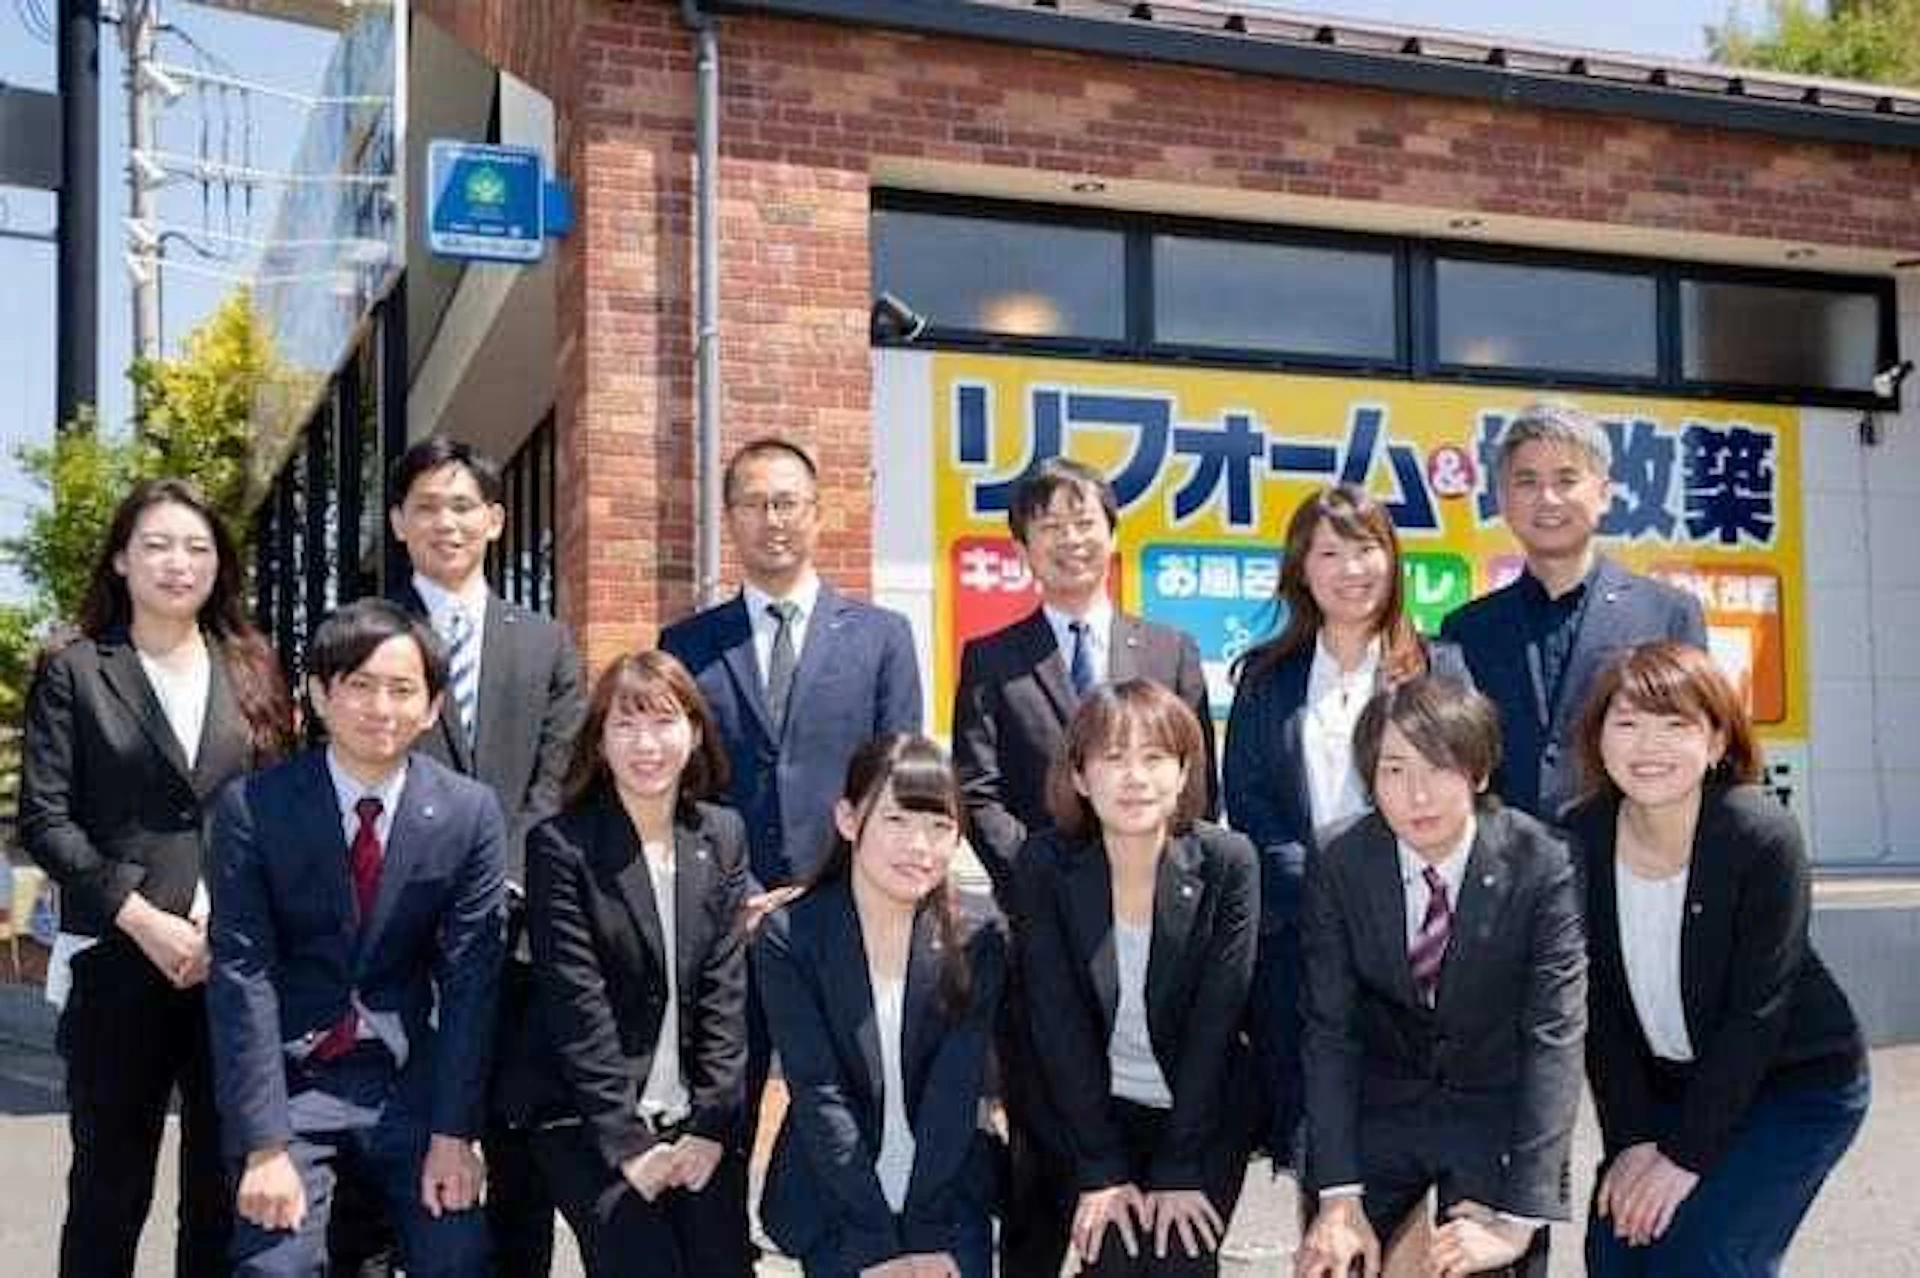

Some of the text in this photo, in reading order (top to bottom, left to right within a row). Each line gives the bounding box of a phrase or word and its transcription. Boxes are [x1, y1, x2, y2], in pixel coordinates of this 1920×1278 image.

[954, 382, 1776, 545] リフォーム&改築
